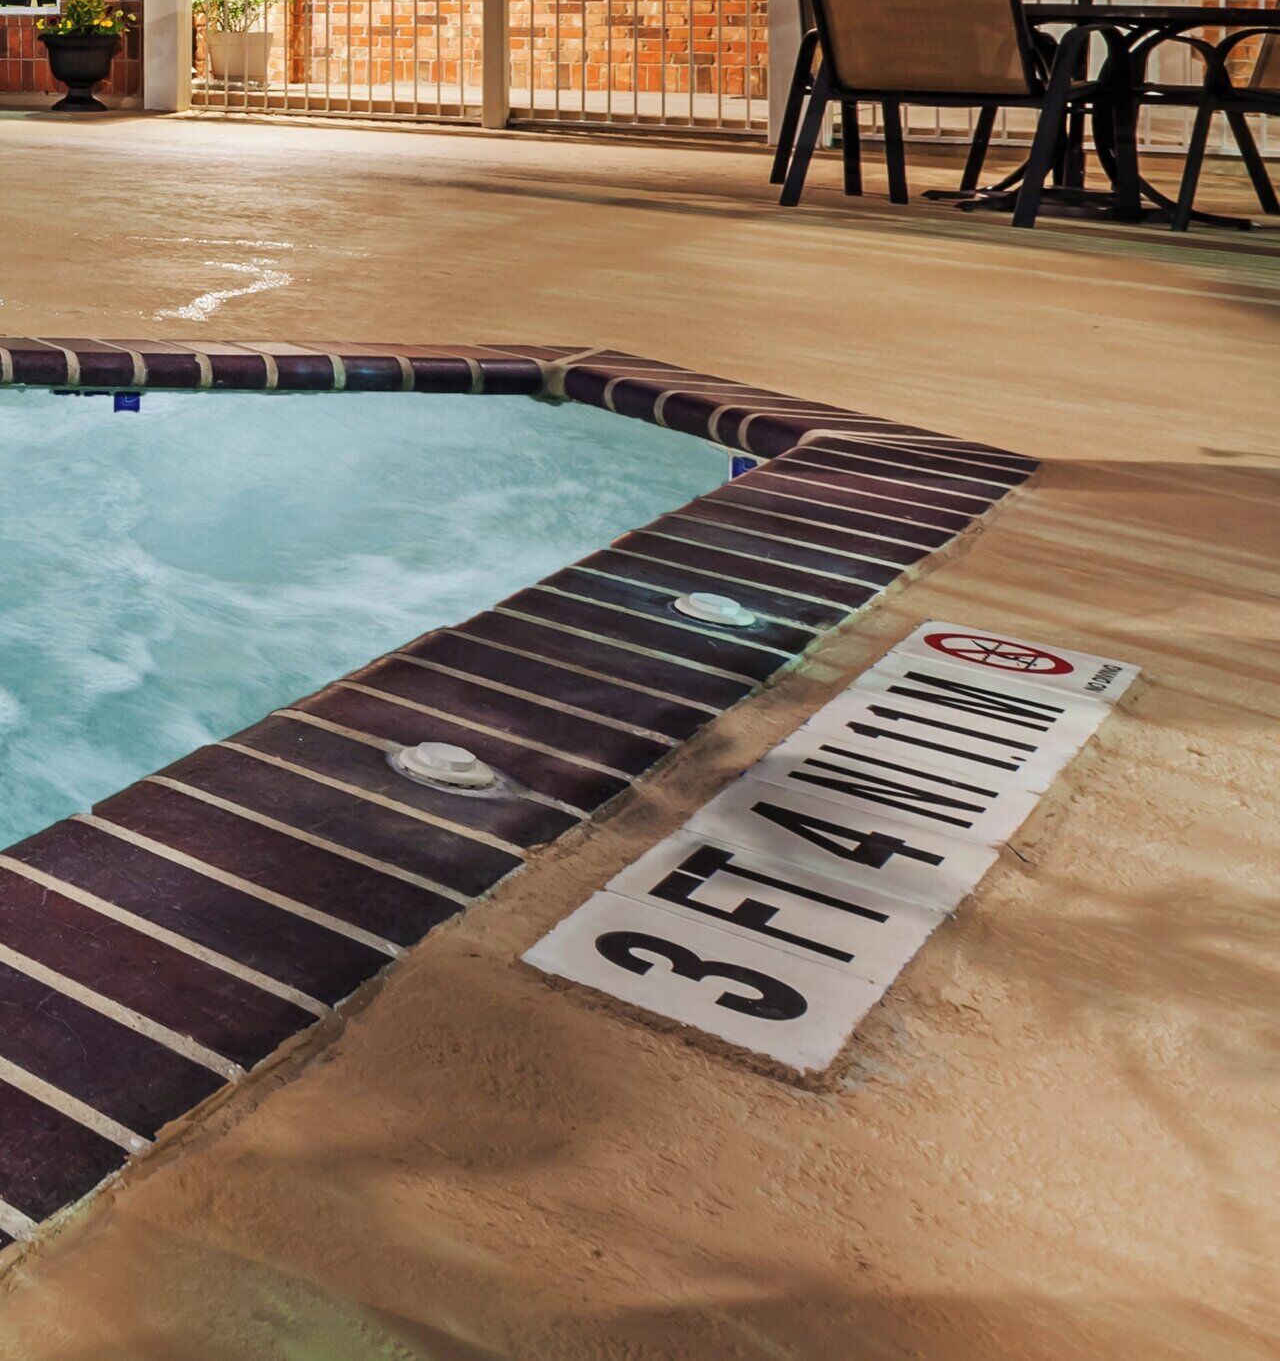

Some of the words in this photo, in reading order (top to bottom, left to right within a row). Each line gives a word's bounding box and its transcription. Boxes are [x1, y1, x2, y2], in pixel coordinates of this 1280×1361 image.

[1083, 681, 1108, 693] NO
[1091, 664, 1123, 684] DIVING
[750, 801, 946, 869] 4
[647, 844, 890, 963] FT
[595, 931, 808, 1021] 3
